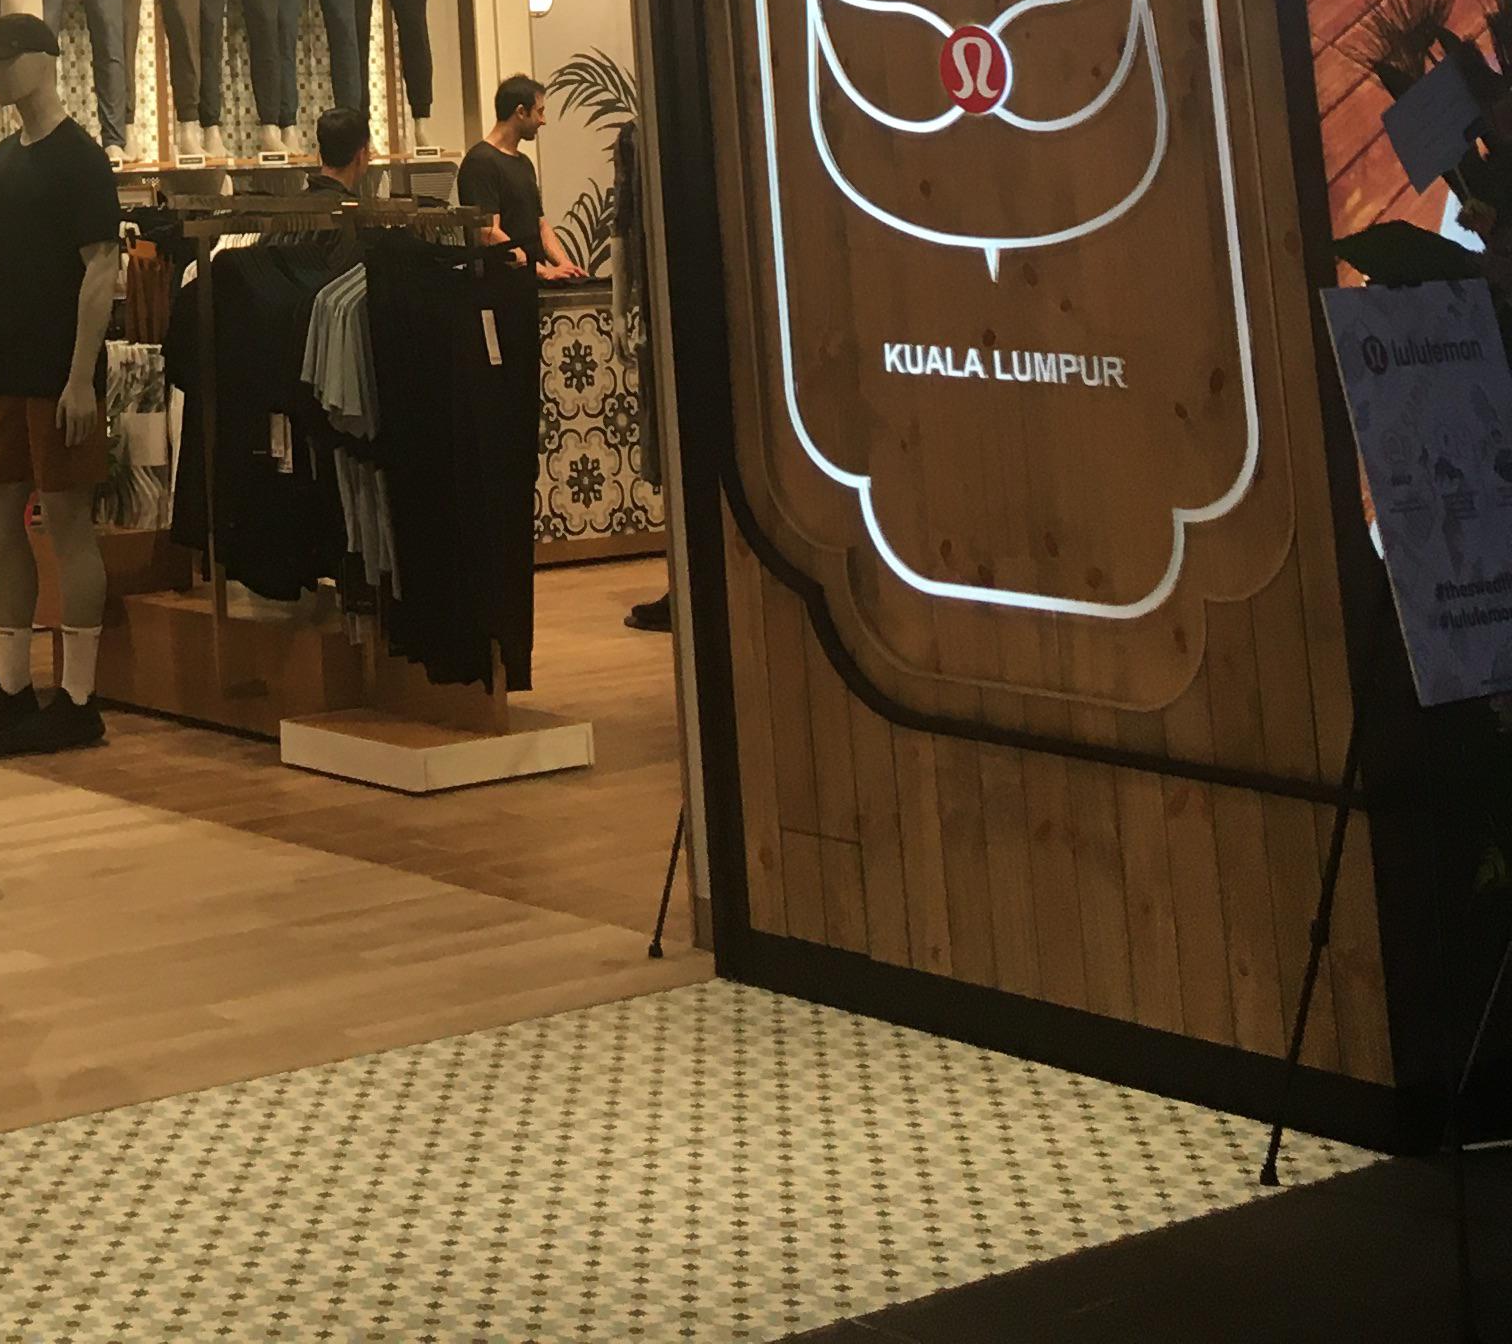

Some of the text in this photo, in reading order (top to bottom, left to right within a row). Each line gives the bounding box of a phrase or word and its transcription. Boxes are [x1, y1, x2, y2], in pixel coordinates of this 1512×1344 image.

[883, 342, 1128, 389] KUALA LUMPUR
[1391, 336, 1484, 367] lululemon
